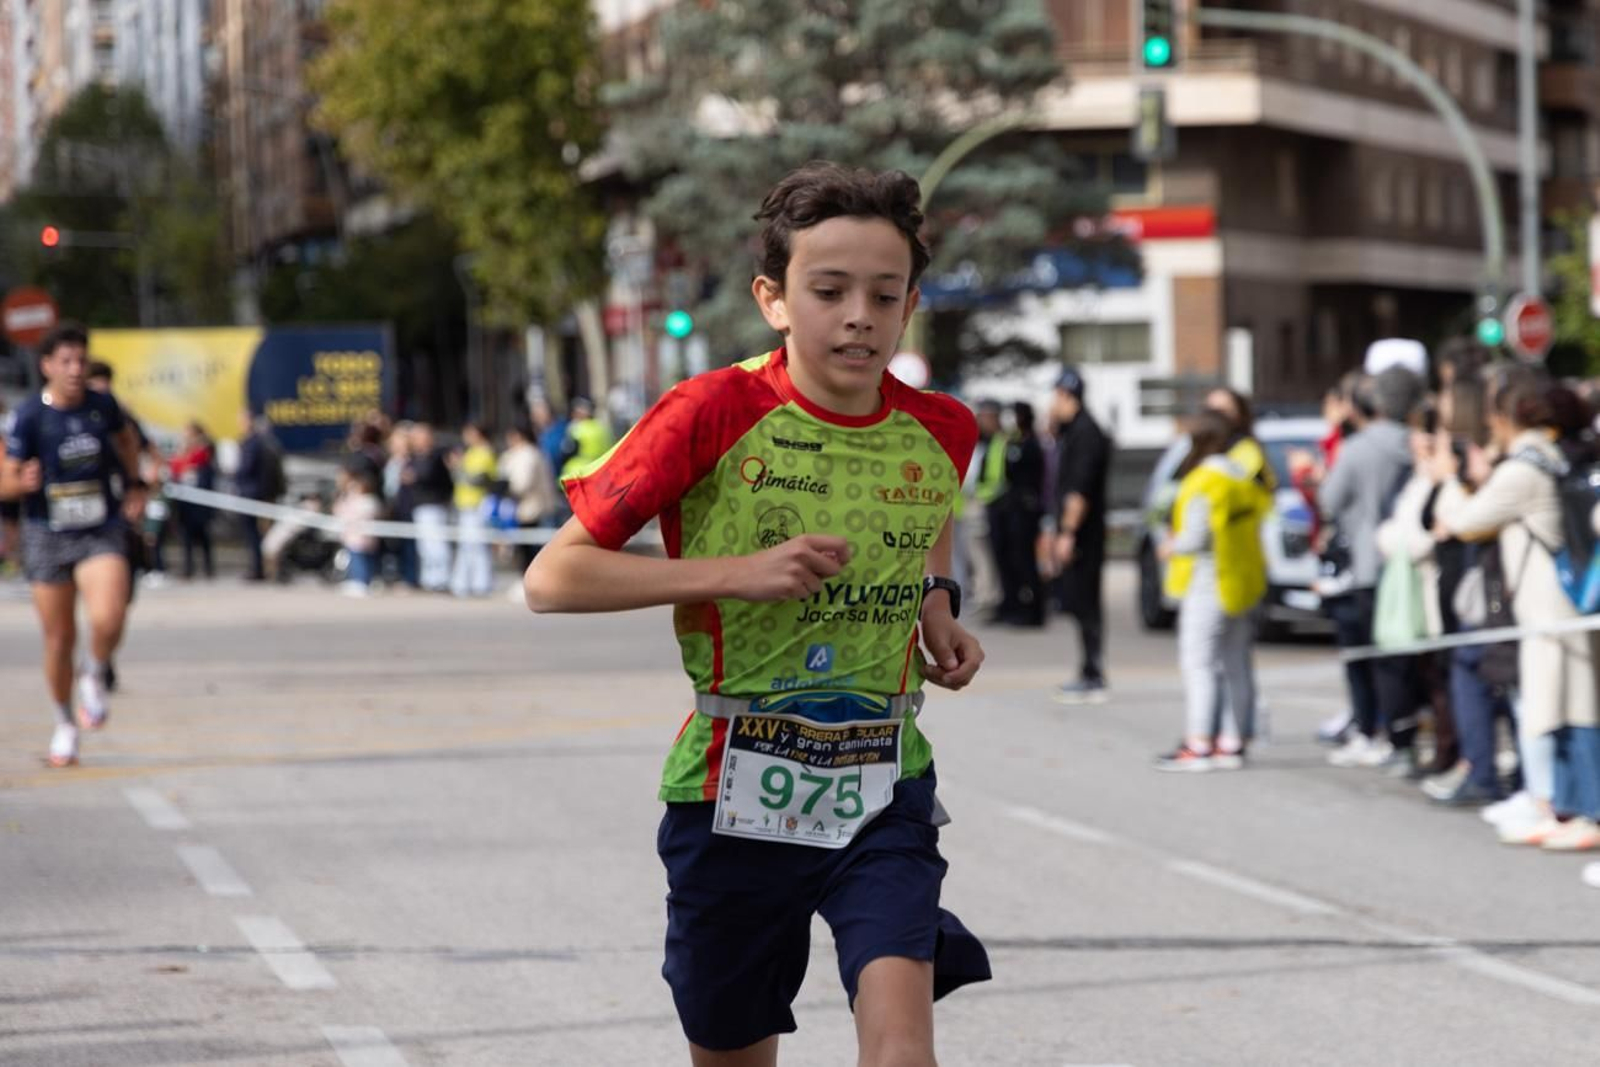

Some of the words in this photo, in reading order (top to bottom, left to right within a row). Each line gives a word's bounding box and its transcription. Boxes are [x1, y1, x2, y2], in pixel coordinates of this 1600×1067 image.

[738, 717, 779, 739] XXV
[797, 738, 832, 751] gran
[838, 736, 893, 751] caminata
[759, 764, 864, 819] 975
